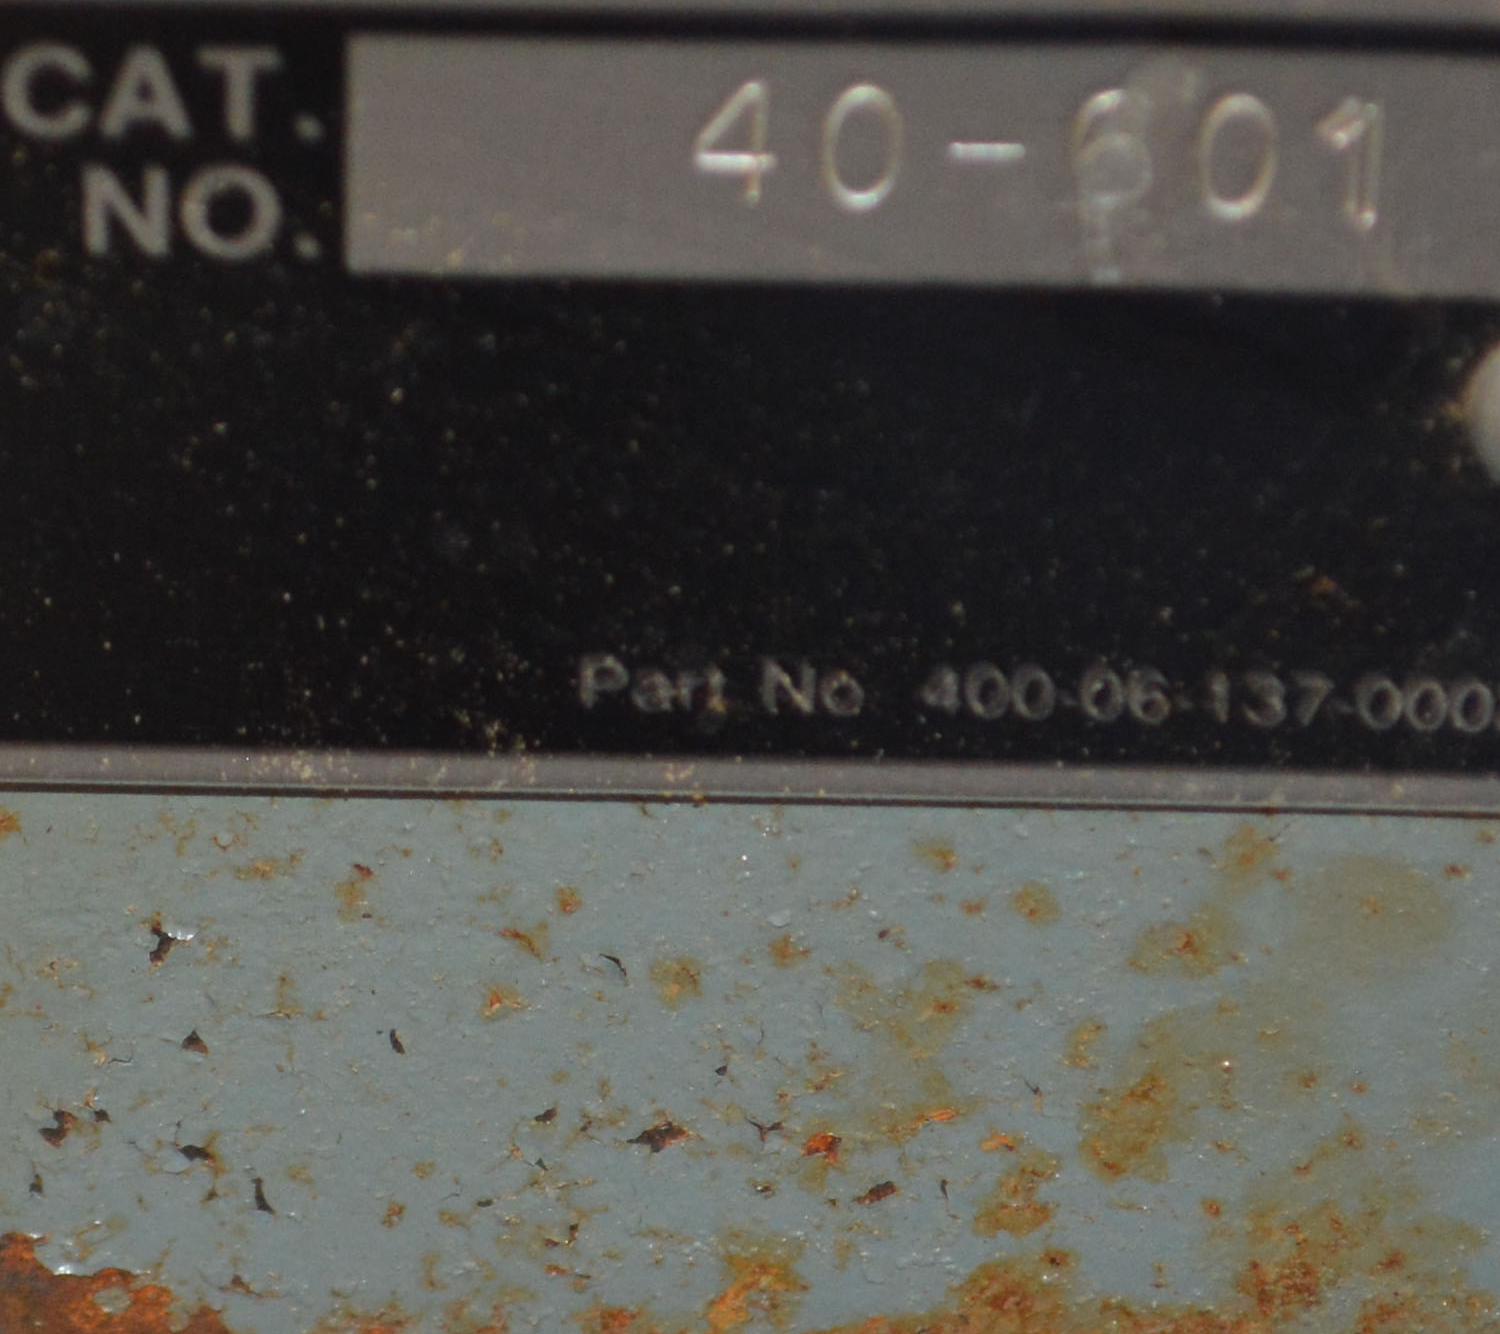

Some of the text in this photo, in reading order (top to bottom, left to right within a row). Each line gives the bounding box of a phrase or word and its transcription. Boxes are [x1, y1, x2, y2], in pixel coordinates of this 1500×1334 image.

[0, 37, 325, 143] CAT.
[692, 77, 1386, 235] 40-601
[80, 163, 323, 261] NO.
